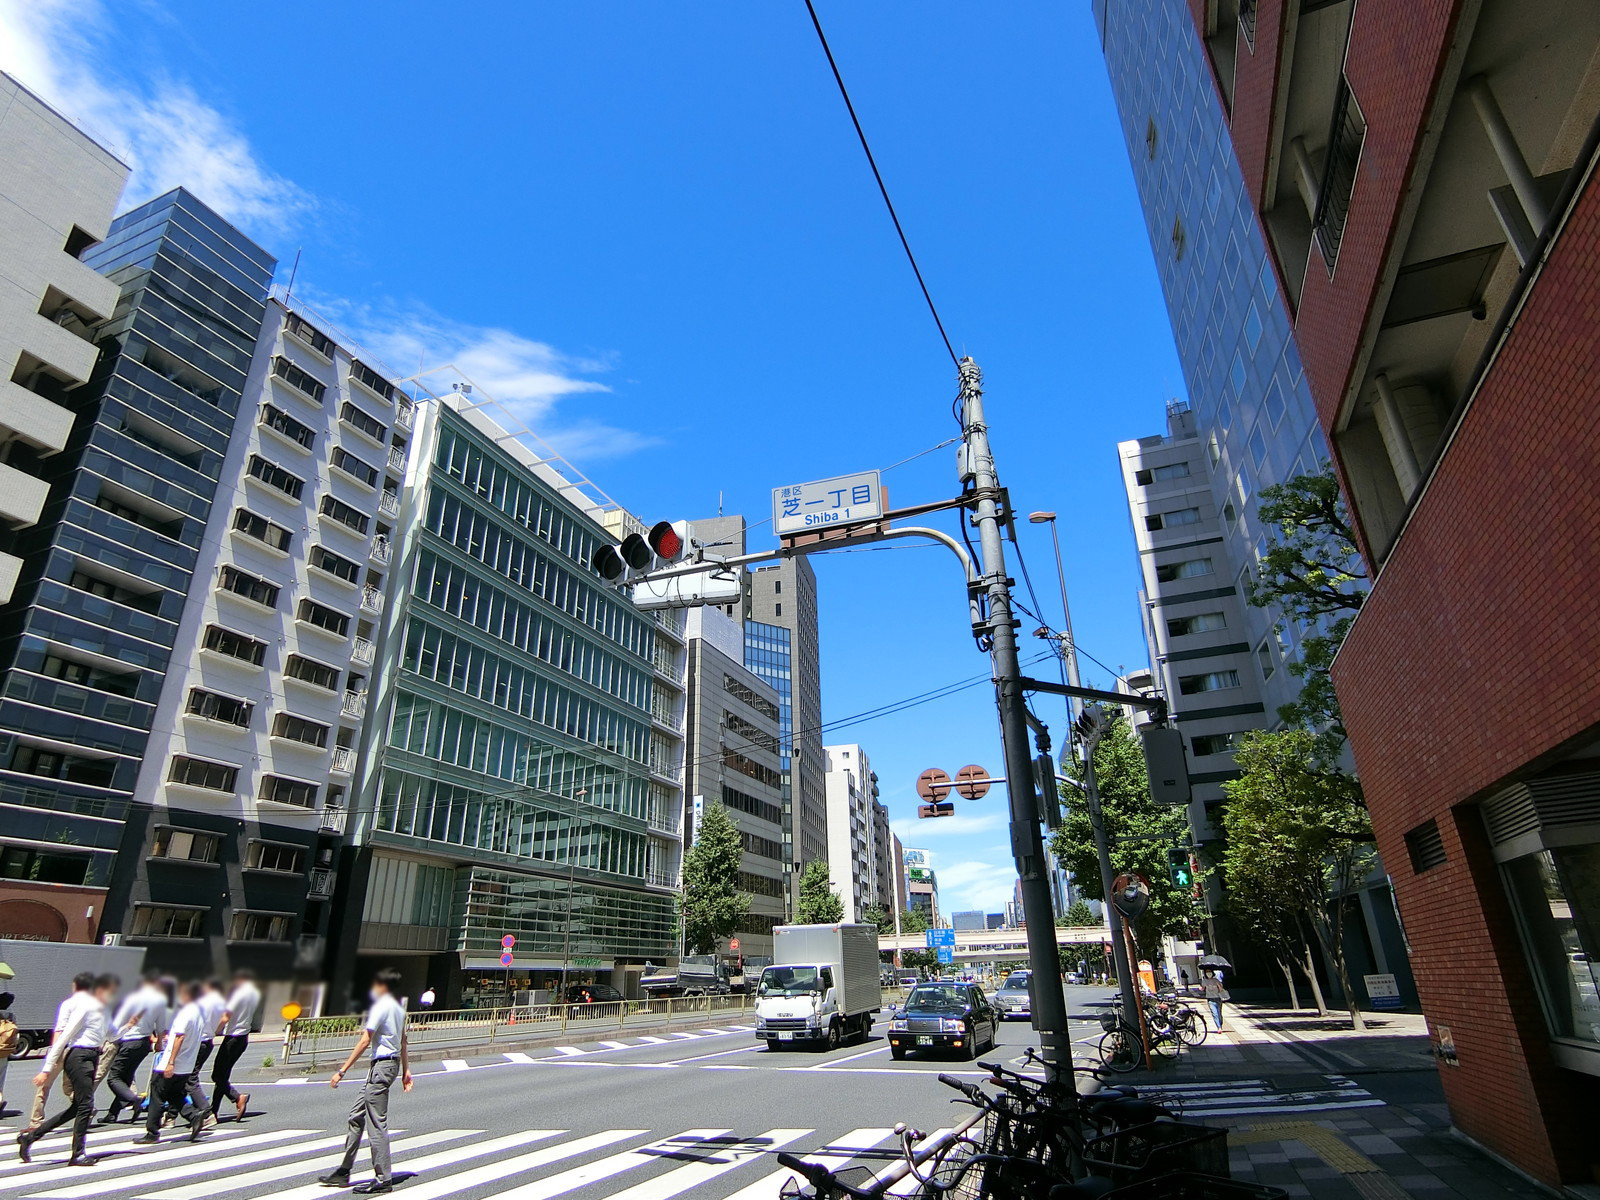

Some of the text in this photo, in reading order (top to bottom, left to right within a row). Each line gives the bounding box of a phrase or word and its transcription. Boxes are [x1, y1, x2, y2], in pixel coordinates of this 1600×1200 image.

[781, 486, 802, 498] 港区
[782, 484, 871, 518] 芝一丁目
[805, 508, 851, 525] Shiba 1
